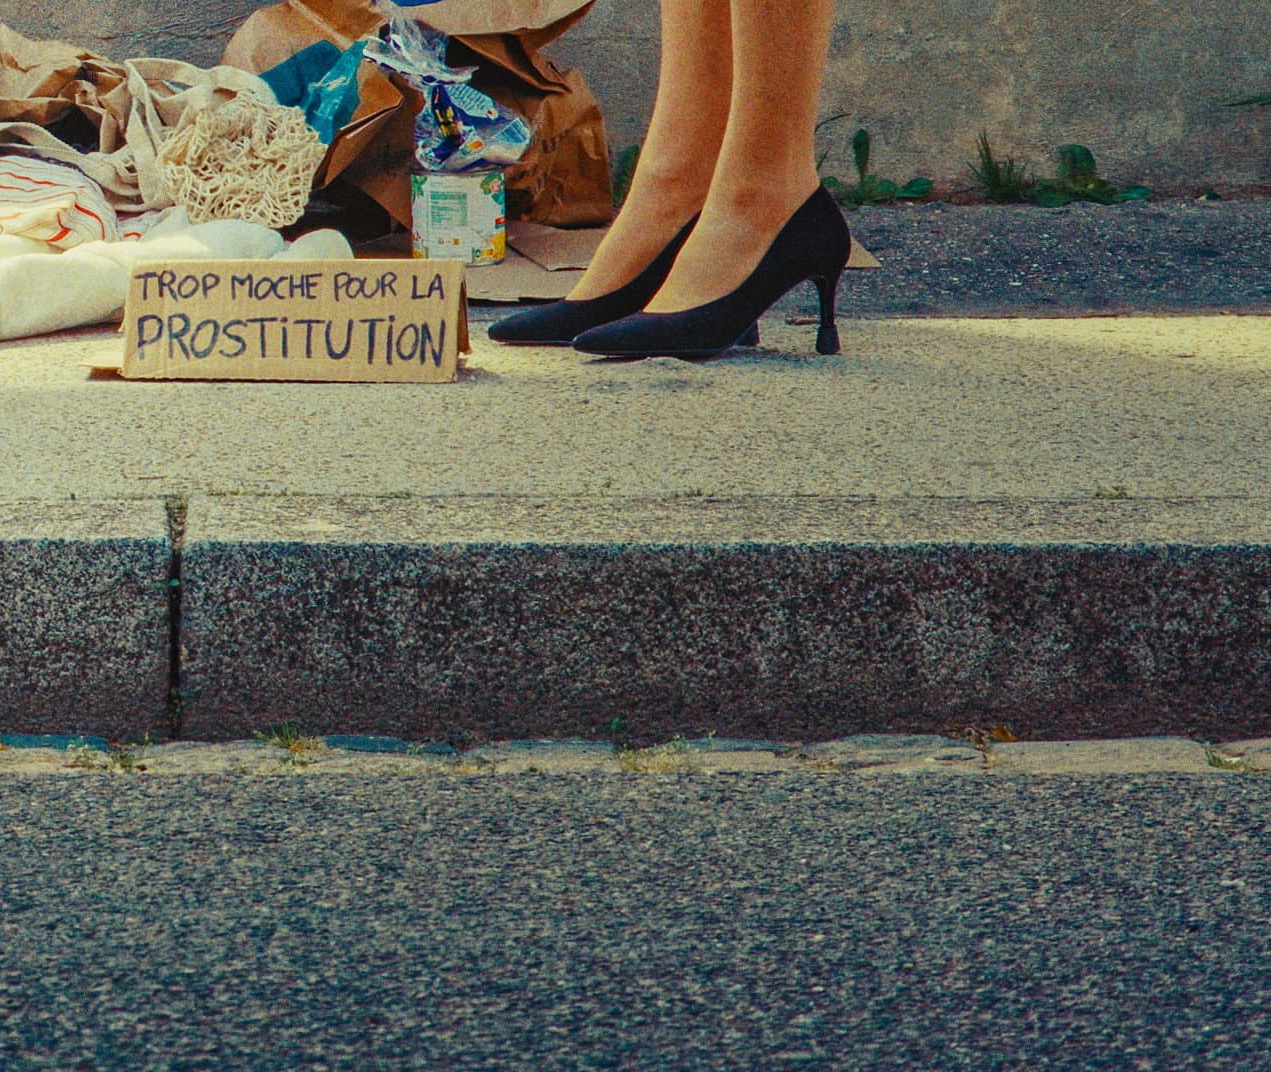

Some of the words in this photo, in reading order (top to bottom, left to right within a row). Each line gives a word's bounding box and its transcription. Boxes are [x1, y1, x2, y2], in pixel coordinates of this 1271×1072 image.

[135, 270, 220, 302] TROP
[231, 271, 323, 301] MOCHE
[333, 271, 397, 302] POUR
[411, 272, 445, 301] LA
